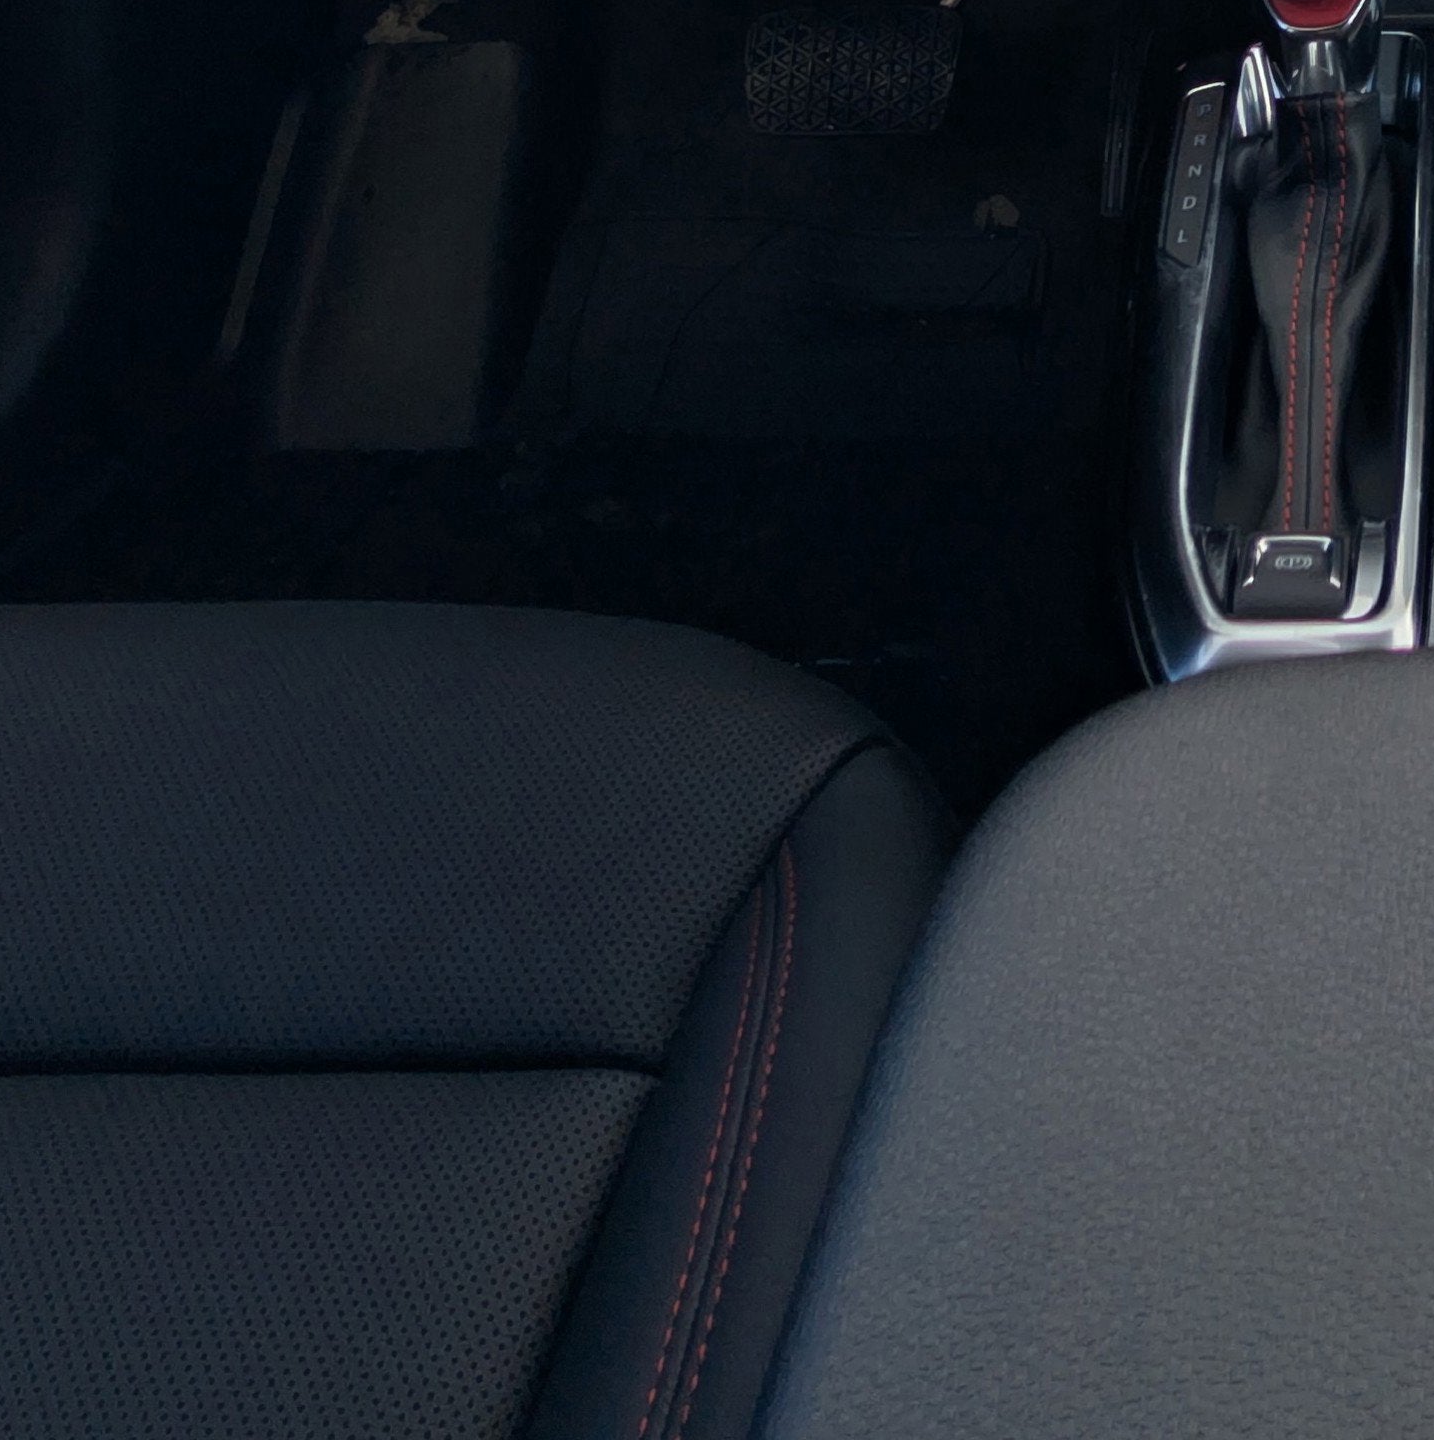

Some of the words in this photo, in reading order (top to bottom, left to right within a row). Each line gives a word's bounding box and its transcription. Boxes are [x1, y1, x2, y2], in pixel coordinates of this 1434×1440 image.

[1194, 134, 1207, 146] R
[1188, 164, 1202, 178] N
[1182, 196, 1197, 210] D
[1177, 229, 1188, 243] L
